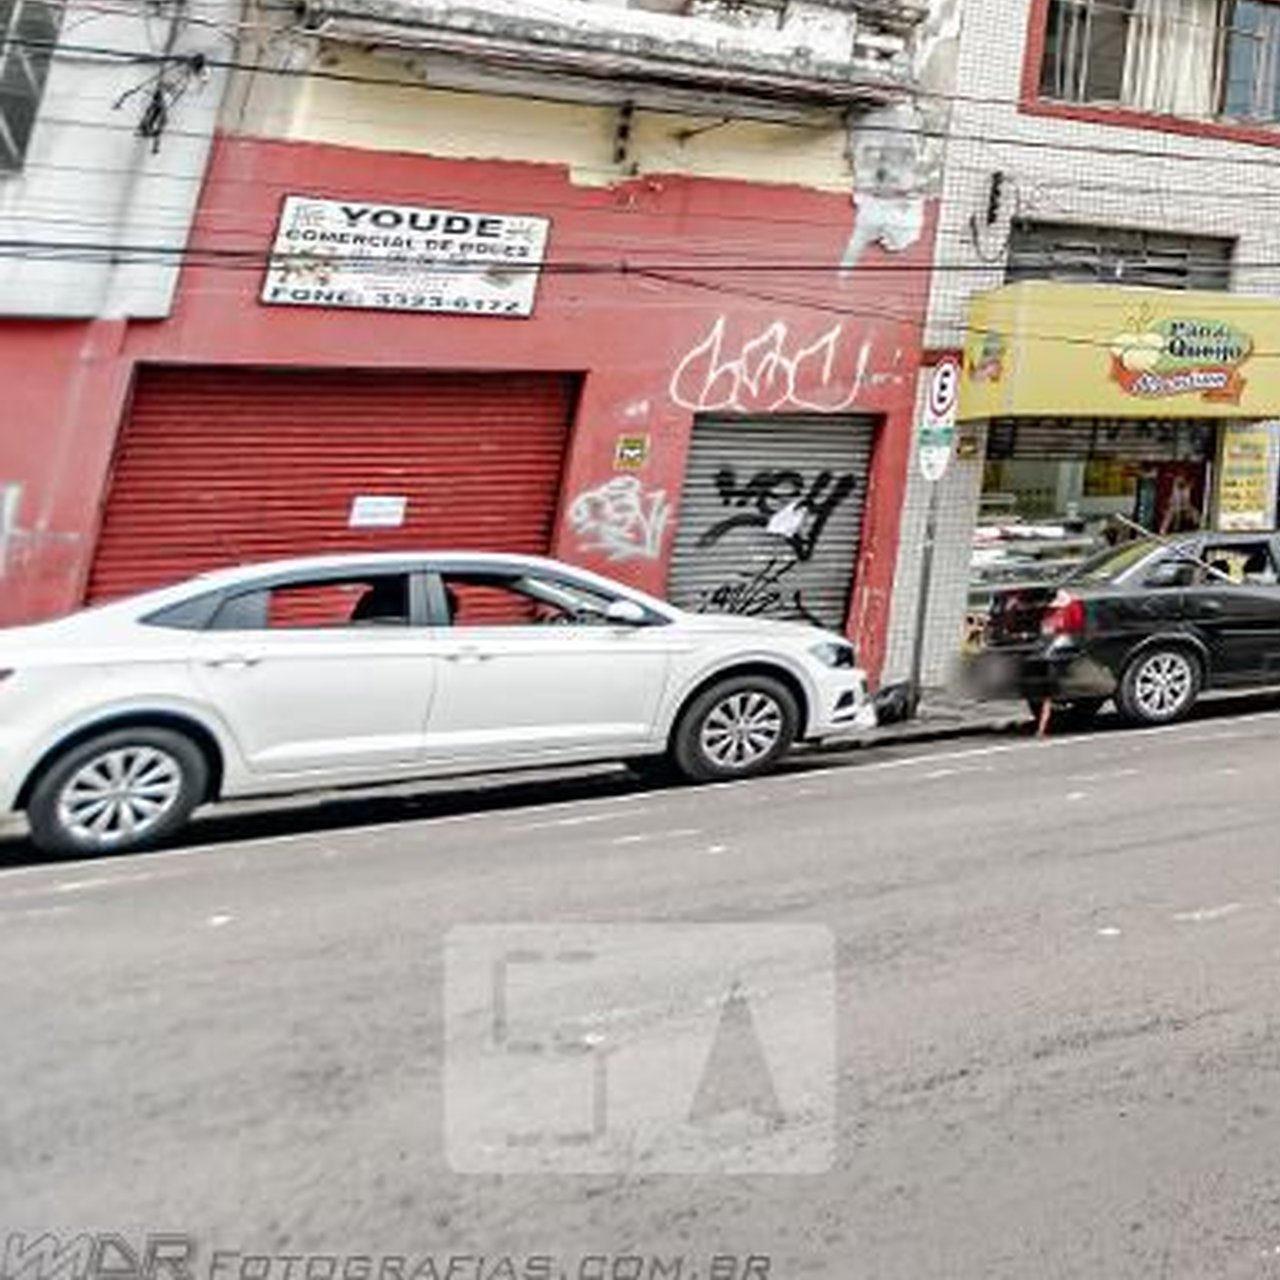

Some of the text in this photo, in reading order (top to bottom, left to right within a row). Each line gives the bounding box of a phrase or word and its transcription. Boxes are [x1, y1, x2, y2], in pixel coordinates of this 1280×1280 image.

[340, 206, 504, 238] YOUDE
[285, 228, 416, 250] COMERCIAL
[425, 238, 454, 252] DE
[1168, 336, 1243, 362] Queijo
